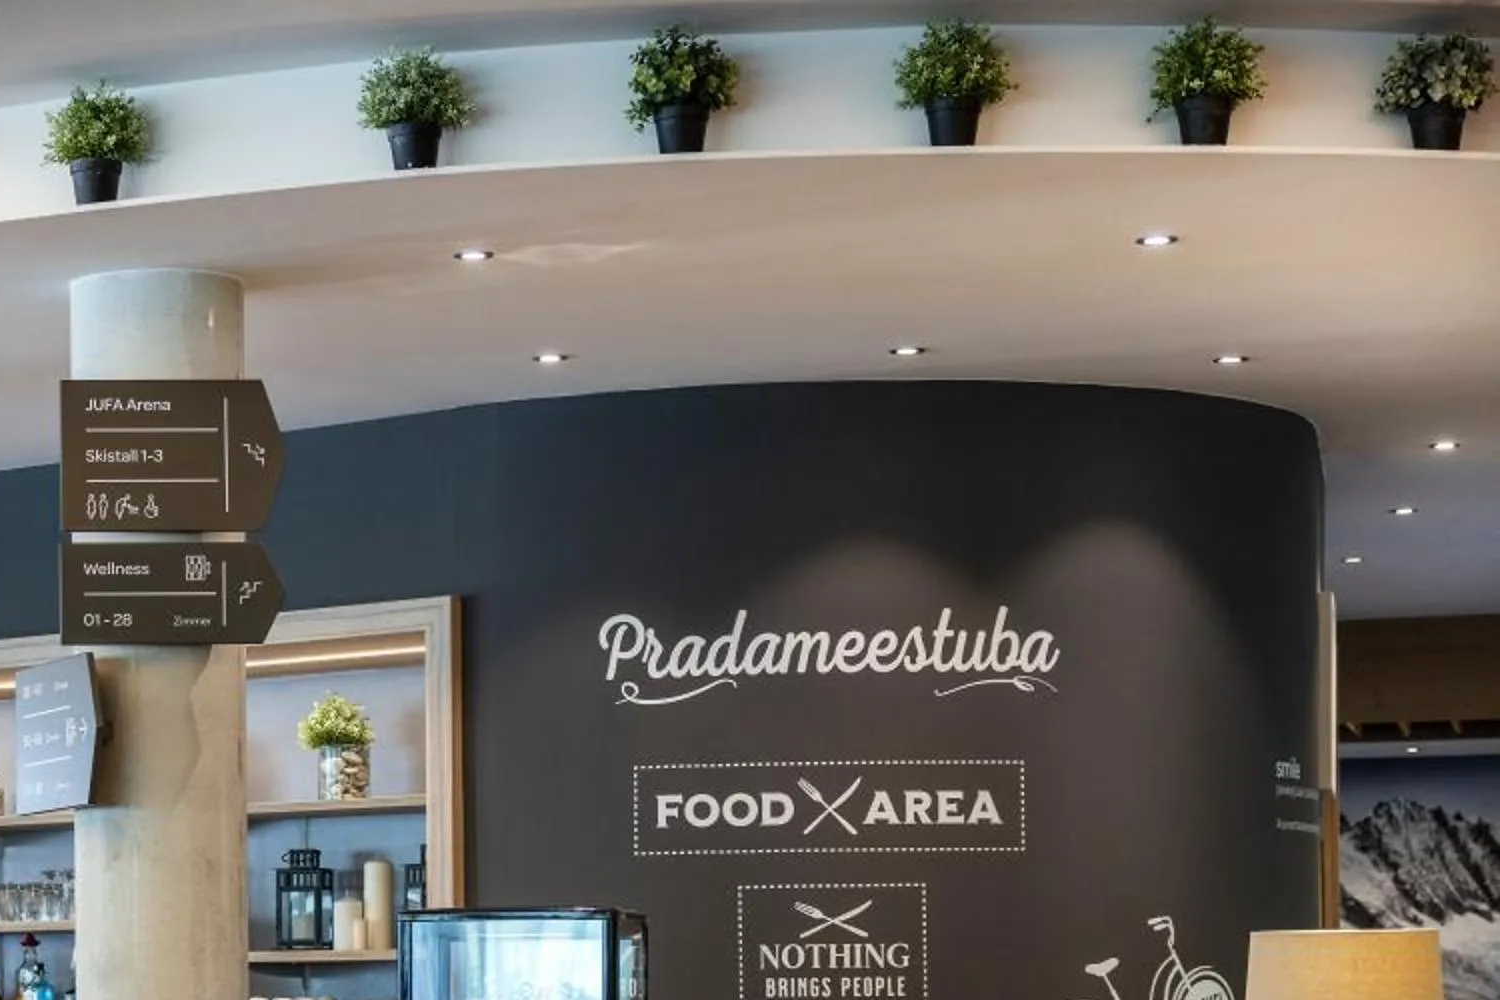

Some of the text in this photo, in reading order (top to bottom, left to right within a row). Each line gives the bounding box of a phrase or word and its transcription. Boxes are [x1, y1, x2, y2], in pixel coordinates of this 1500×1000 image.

[85, 397, 171, 412] JUFA Arena
[85, 449, 163, 463] Skistall 1-3
[83, 561, 149, 576] Wellness
[113, 613, 133, 627] 28
[599, 606, 1060, 682] Pradameestuba
[656, 790, 1003, 828] FOOD AREA
[759, 943, 911, 970] NOTHING
[765, 976, 907, 998] BRINGS PEOPLE
